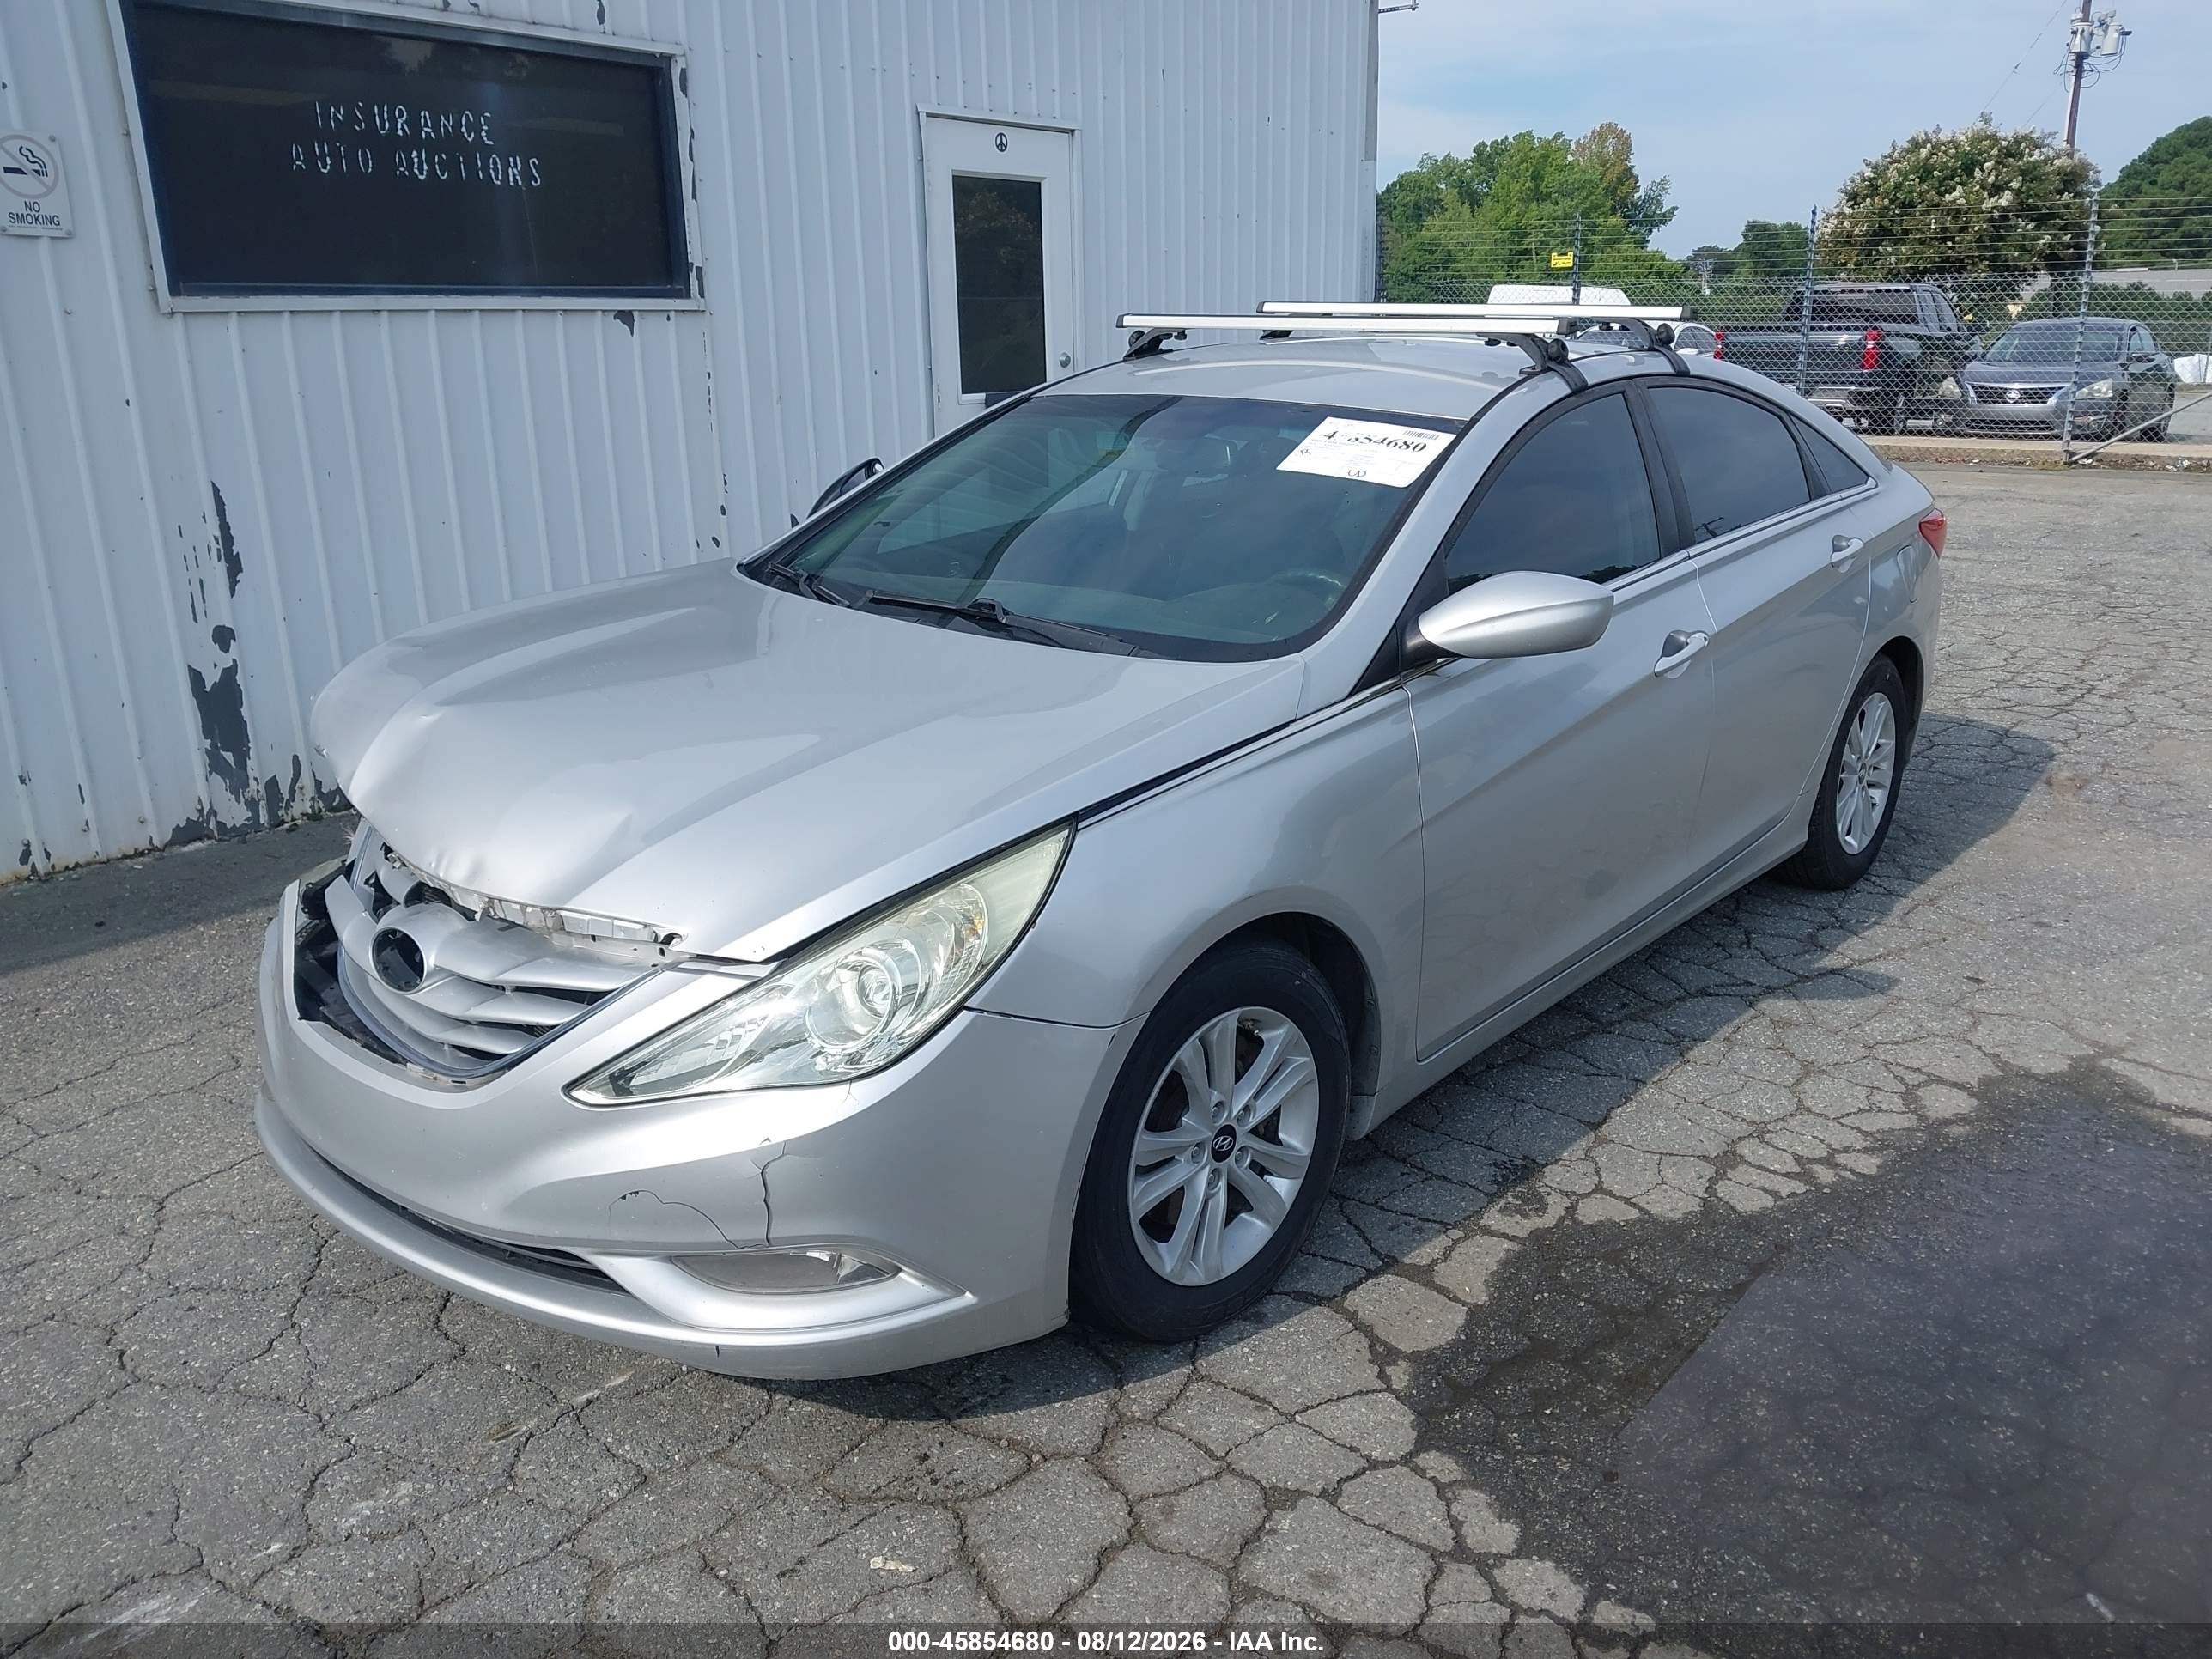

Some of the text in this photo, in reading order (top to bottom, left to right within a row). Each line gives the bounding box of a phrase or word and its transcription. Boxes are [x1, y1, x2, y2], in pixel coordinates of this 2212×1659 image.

[314, 100, 495, 145] INSURANCE
[292, 141, 542, 186] AUTO AUCTIONS
[24, 200, 41, 213] NO
[8, 212, 61, 226] SMOKING
[1323, 430, 1428, 453] 454680
